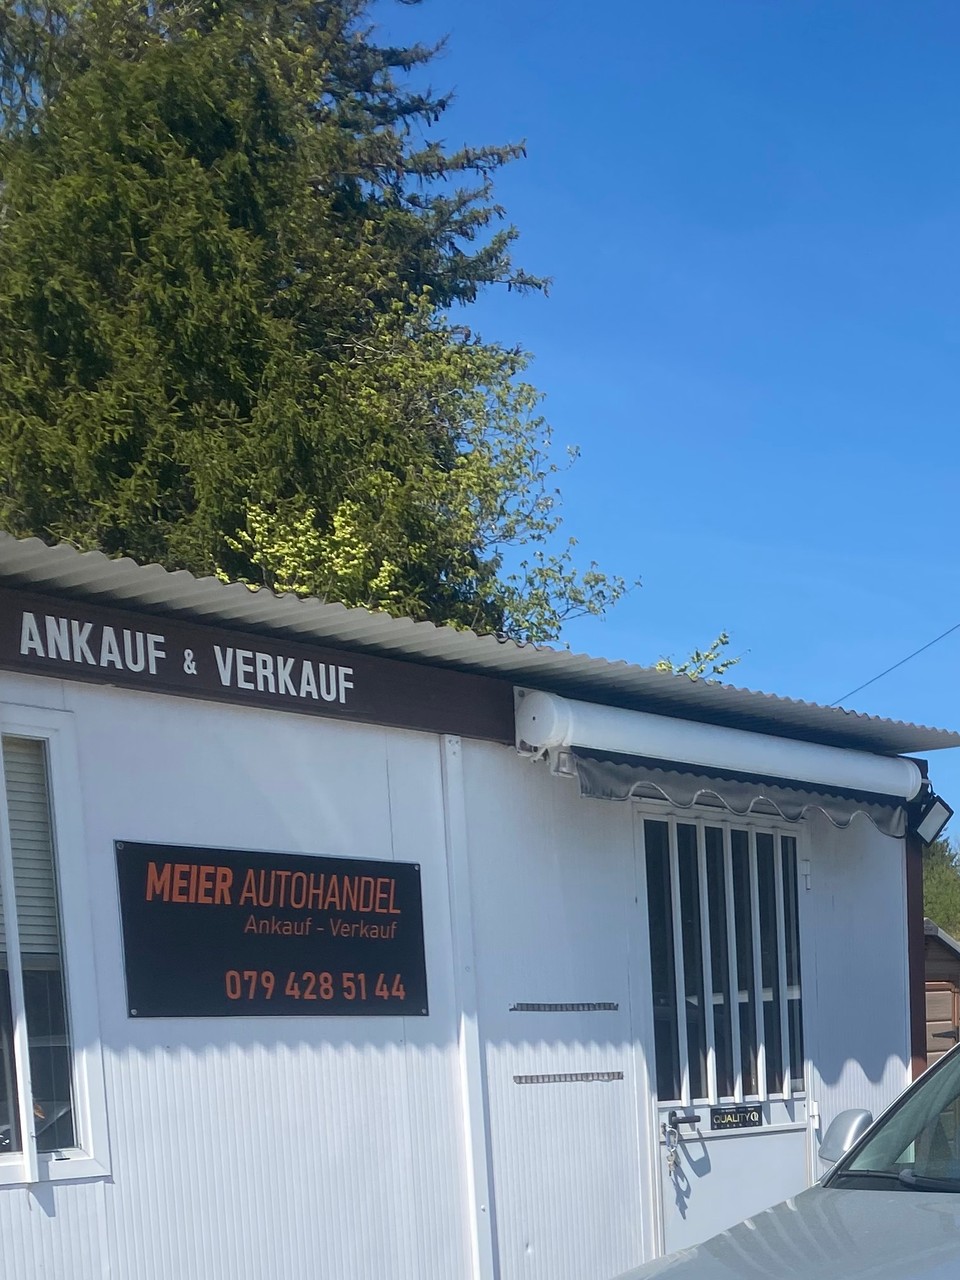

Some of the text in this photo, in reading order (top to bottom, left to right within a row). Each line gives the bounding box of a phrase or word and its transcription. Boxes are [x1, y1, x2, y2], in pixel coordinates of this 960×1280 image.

[20, 611, 354, 704] ANKAUF & VERKAUF
[146, 861, 401, 914] MEIER AUTOHANDEL
[244, 915, 313, 936] Ankauf
[329, 917, 398, 939] Verkauf
[225, 970, 406, 1000] 079 428 51 44
[713, 1112, 750, 1124] QUALITY
